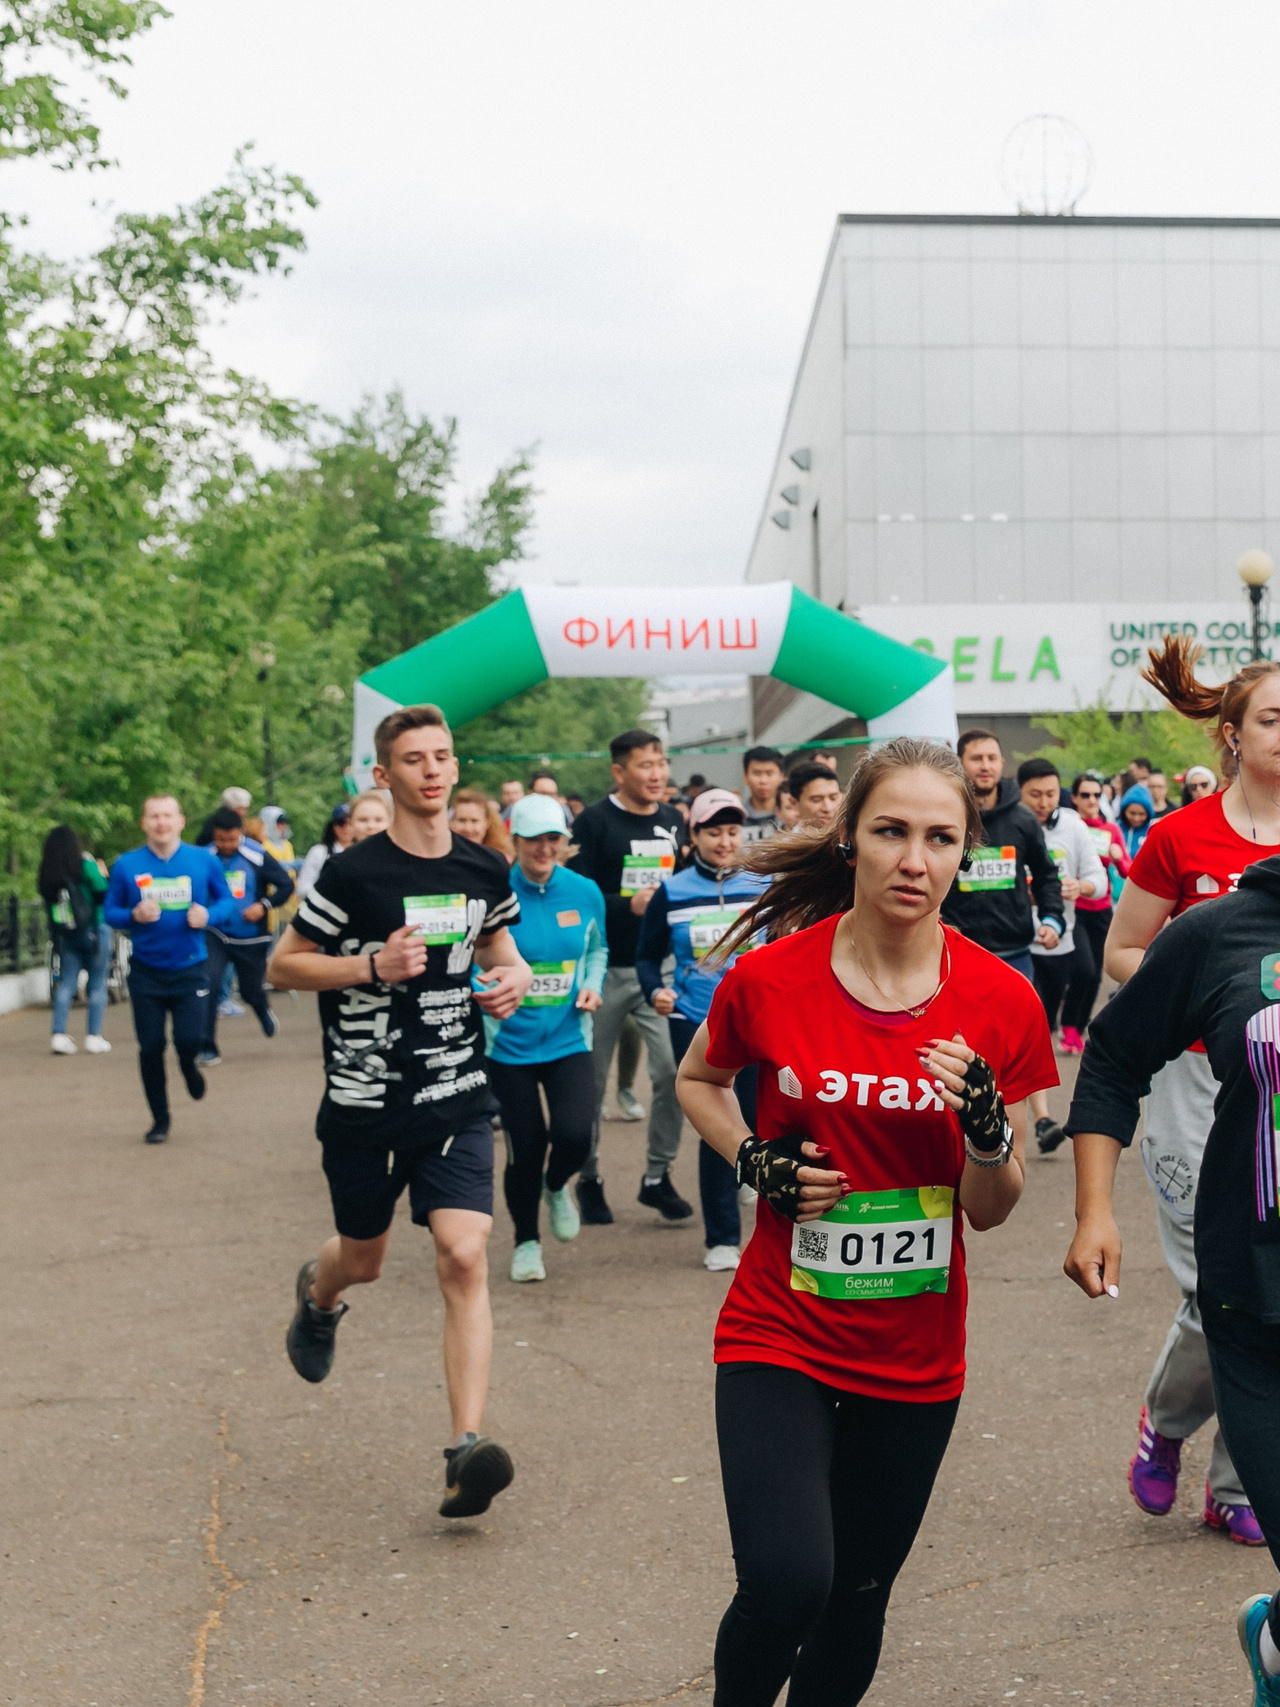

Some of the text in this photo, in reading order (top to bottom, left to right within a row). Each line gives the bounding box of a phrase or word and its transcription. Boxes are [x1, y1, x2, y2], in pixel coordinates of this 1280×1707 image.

[563, 616, 757, 650] ФИНИШ
[1109, 621, 1198, 641] UNITED
[977, 863, 1011, 877] 0537
[840, 1227, 935, 1266] 0121
[845, 1276, 894, 1289] бежим
